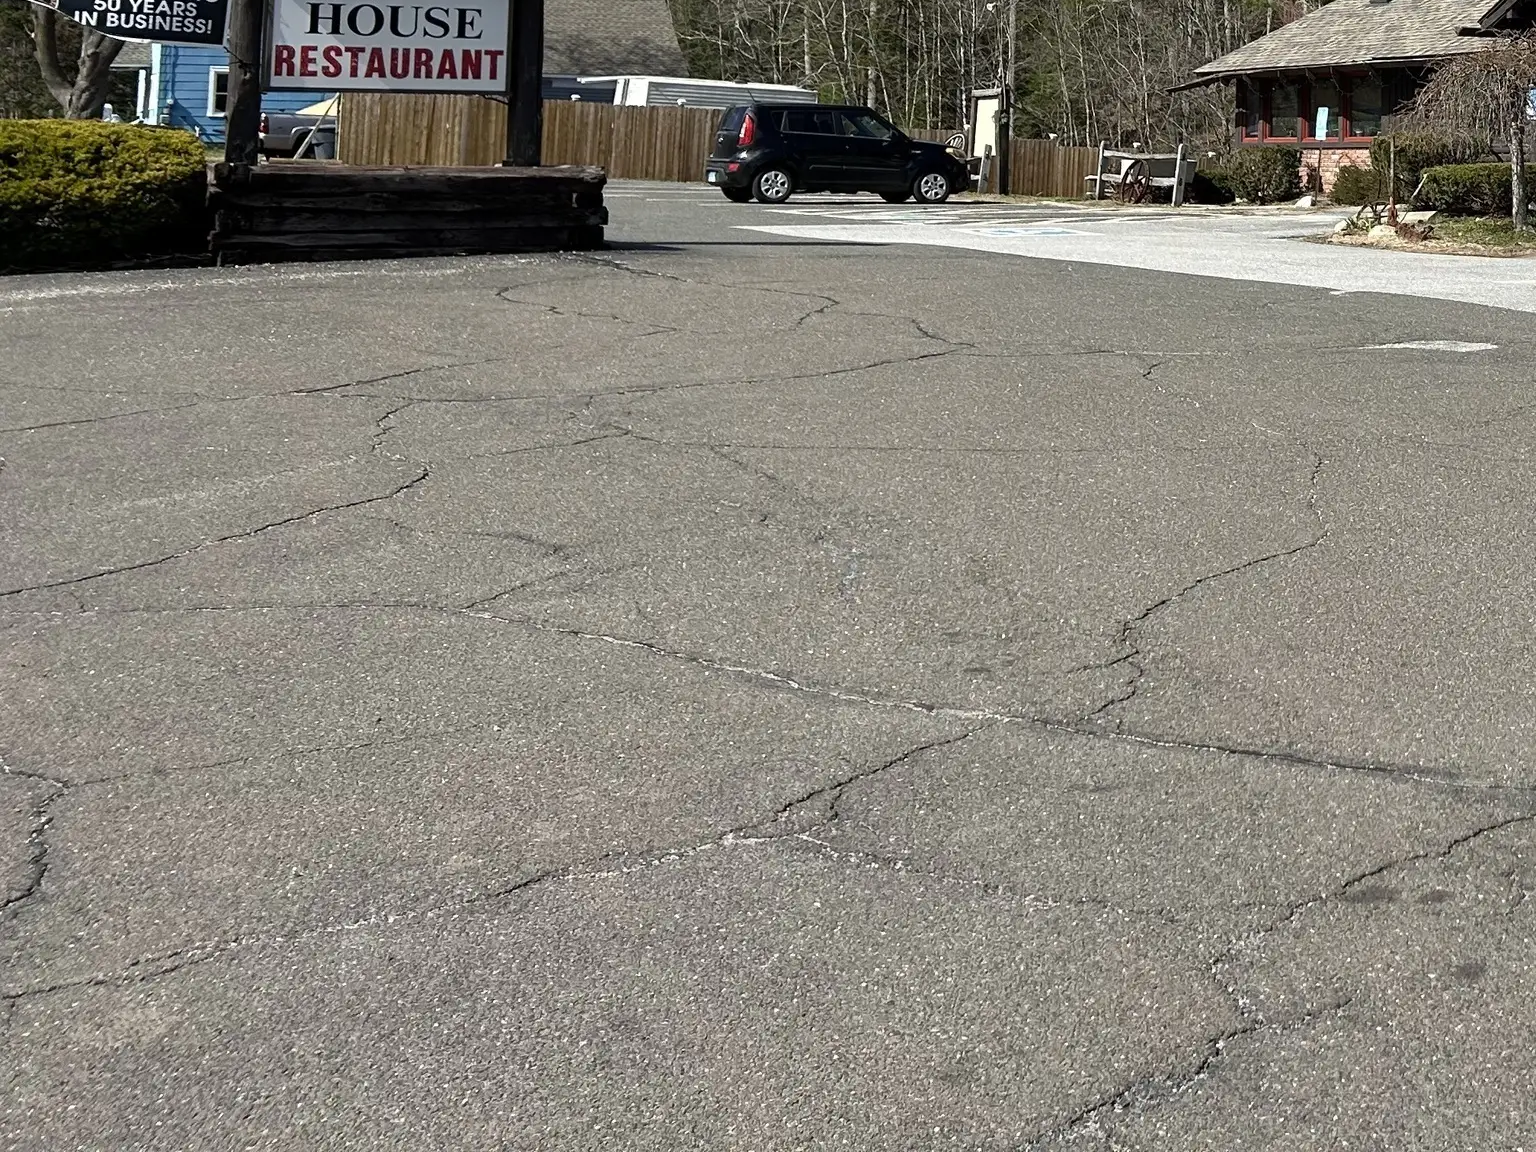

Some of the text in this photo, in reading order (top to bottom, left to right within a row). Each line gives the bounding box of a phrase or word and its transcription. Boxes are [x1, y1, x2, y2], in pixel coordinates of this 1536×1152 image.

[74, 10, 213, 34] IN BUSINESS!
[304, 1, 484, 40] HOUSE
[273, 44, 504, 81] RESTAURANT
